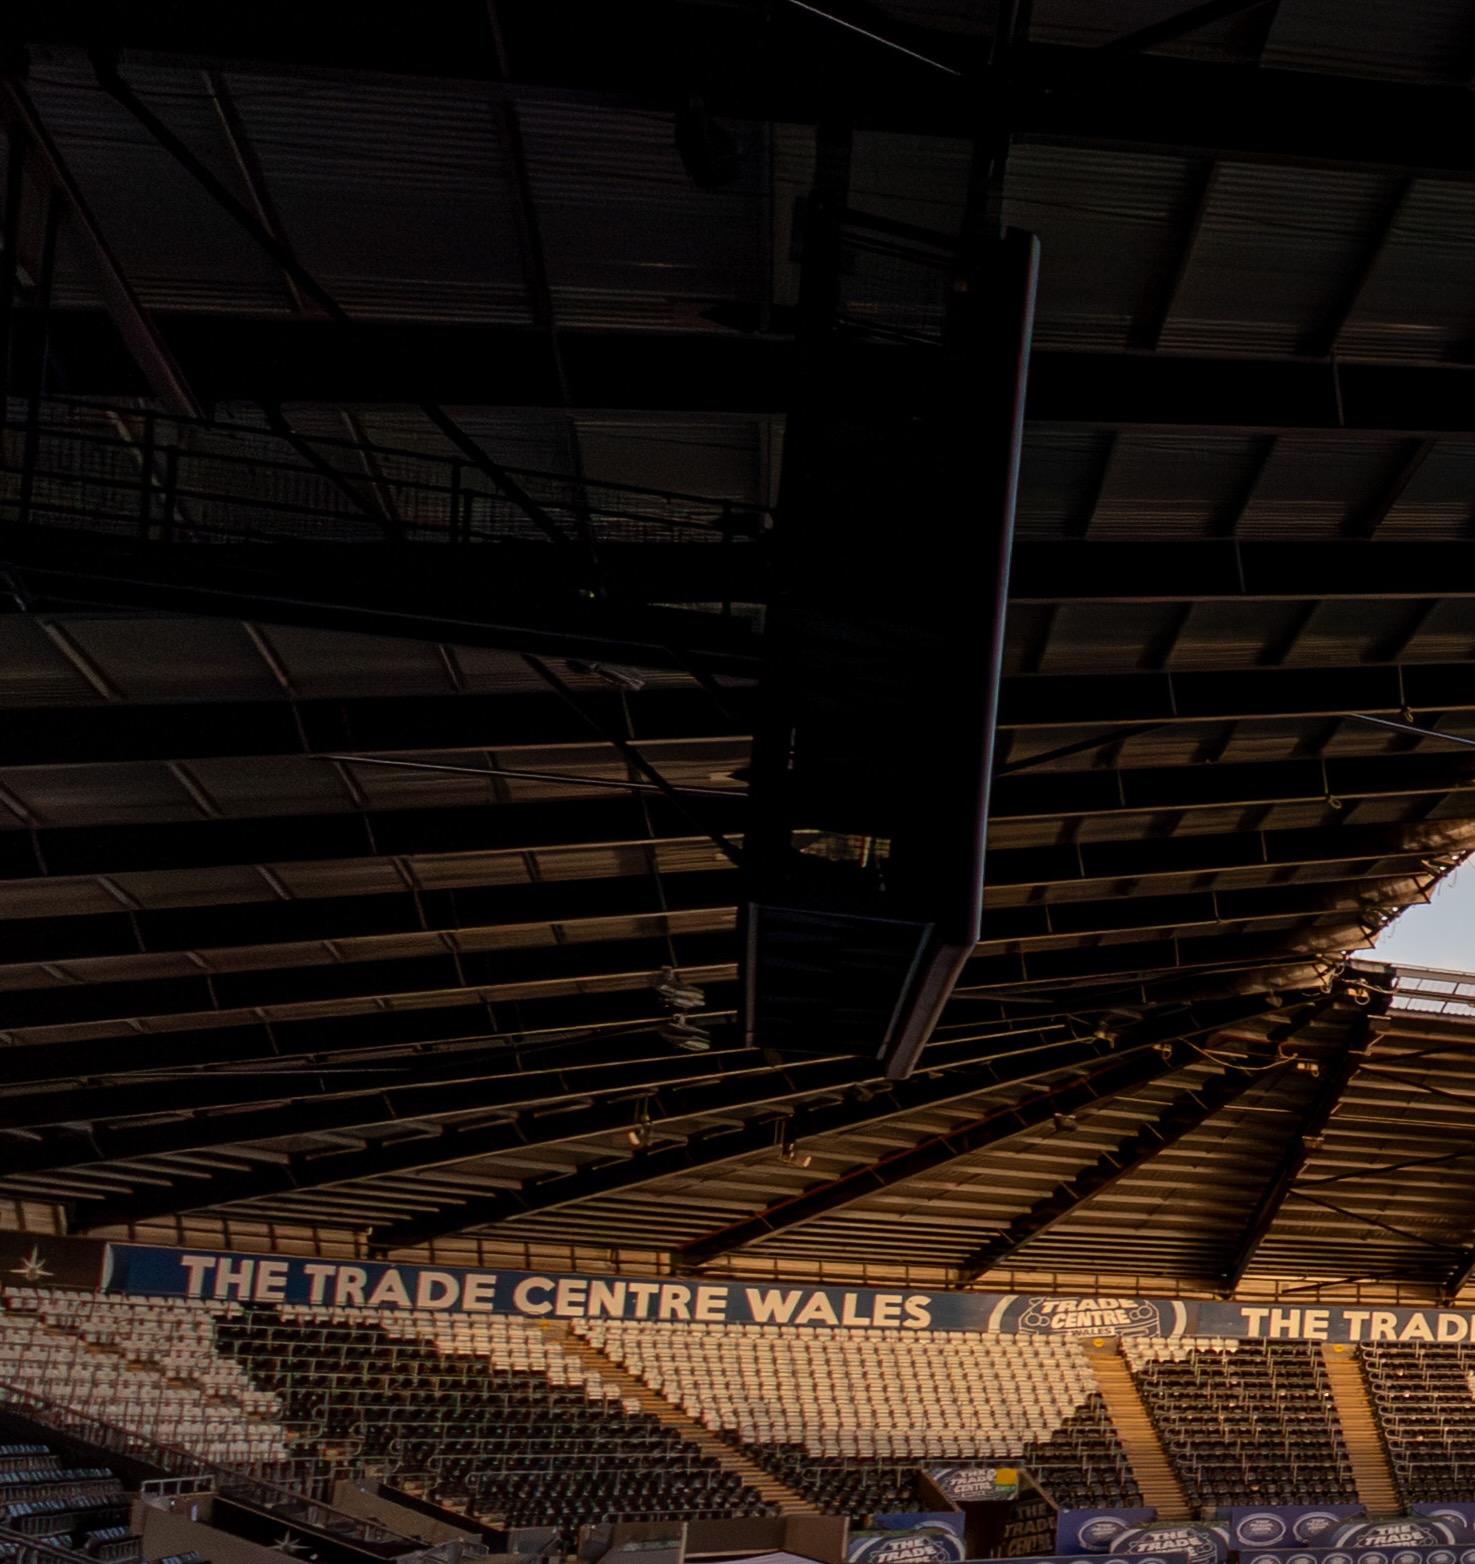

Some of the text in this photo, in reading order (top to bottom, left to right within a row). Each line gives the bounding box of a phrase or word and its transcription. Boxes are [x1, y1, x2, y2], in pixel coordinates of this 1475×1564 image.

[181, 1254, 932, 1329] THE TRADE CENTRE WALES
[1051, 1307, 1132, 1329] CENTRE
[1241, 1307, 1330, 1339] THE
[1070, 1326, 1112, 1336] WALES
[1150, 1529, 1188, 1541] THE
[1376, 1525, 1412, 1535] THE
[889, 1539, 924, 1548] THE
[1137, 1537, 1205, 1552] TRADE
[1364, 1533, 1426, 1545] TRADE
[878, 1546, 938, 1561] TRADE
